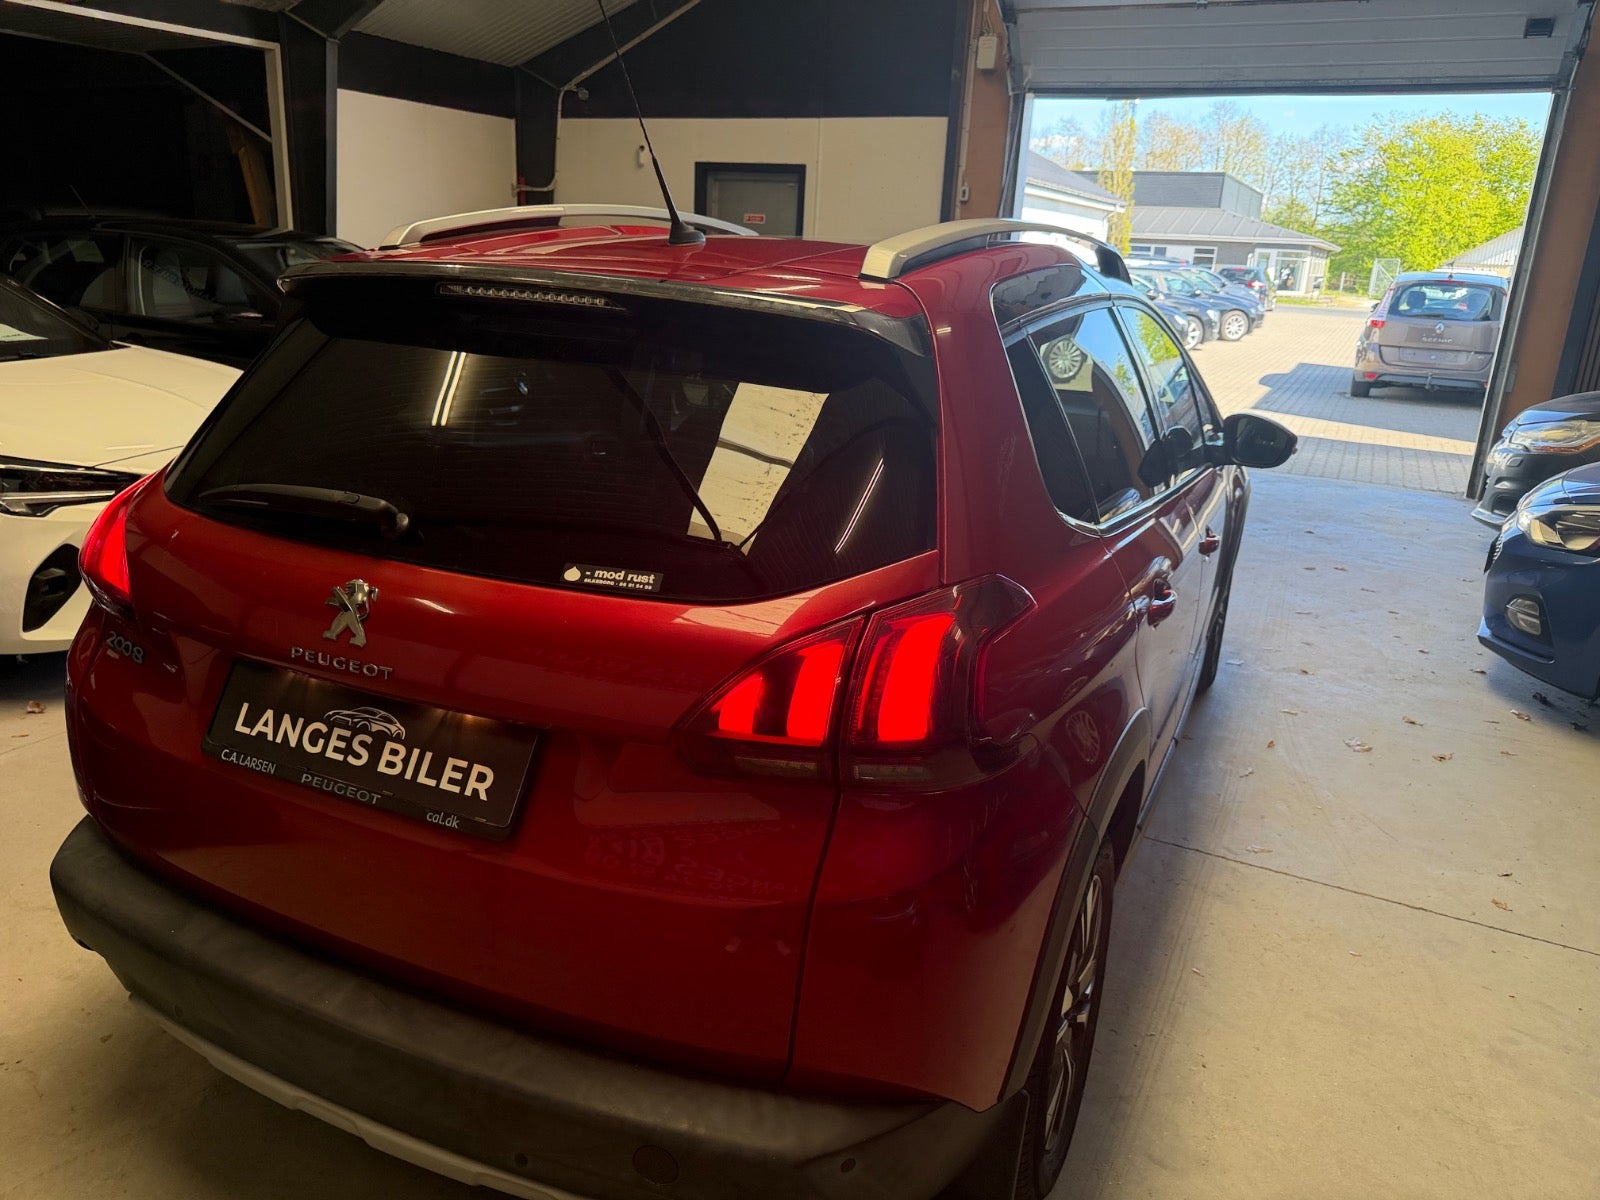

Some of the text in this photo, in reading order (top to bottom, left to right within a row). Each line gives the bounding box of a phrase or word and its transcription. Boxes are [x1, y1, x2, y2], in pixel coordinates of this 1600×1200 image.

[594, 570, 625, 580] mod
[627, 573, 655, 584] rust
[106, 630, 144, 664] 2008
[291, 646, 393, 680] PEUGEOT
[234, 702, 494, 801] LANGES BILER
[239, 754, 277, 775] LARSEN
[301, 773, 383, 805] PEUGEOT
[426, 810, 460, 829] cal.dk
